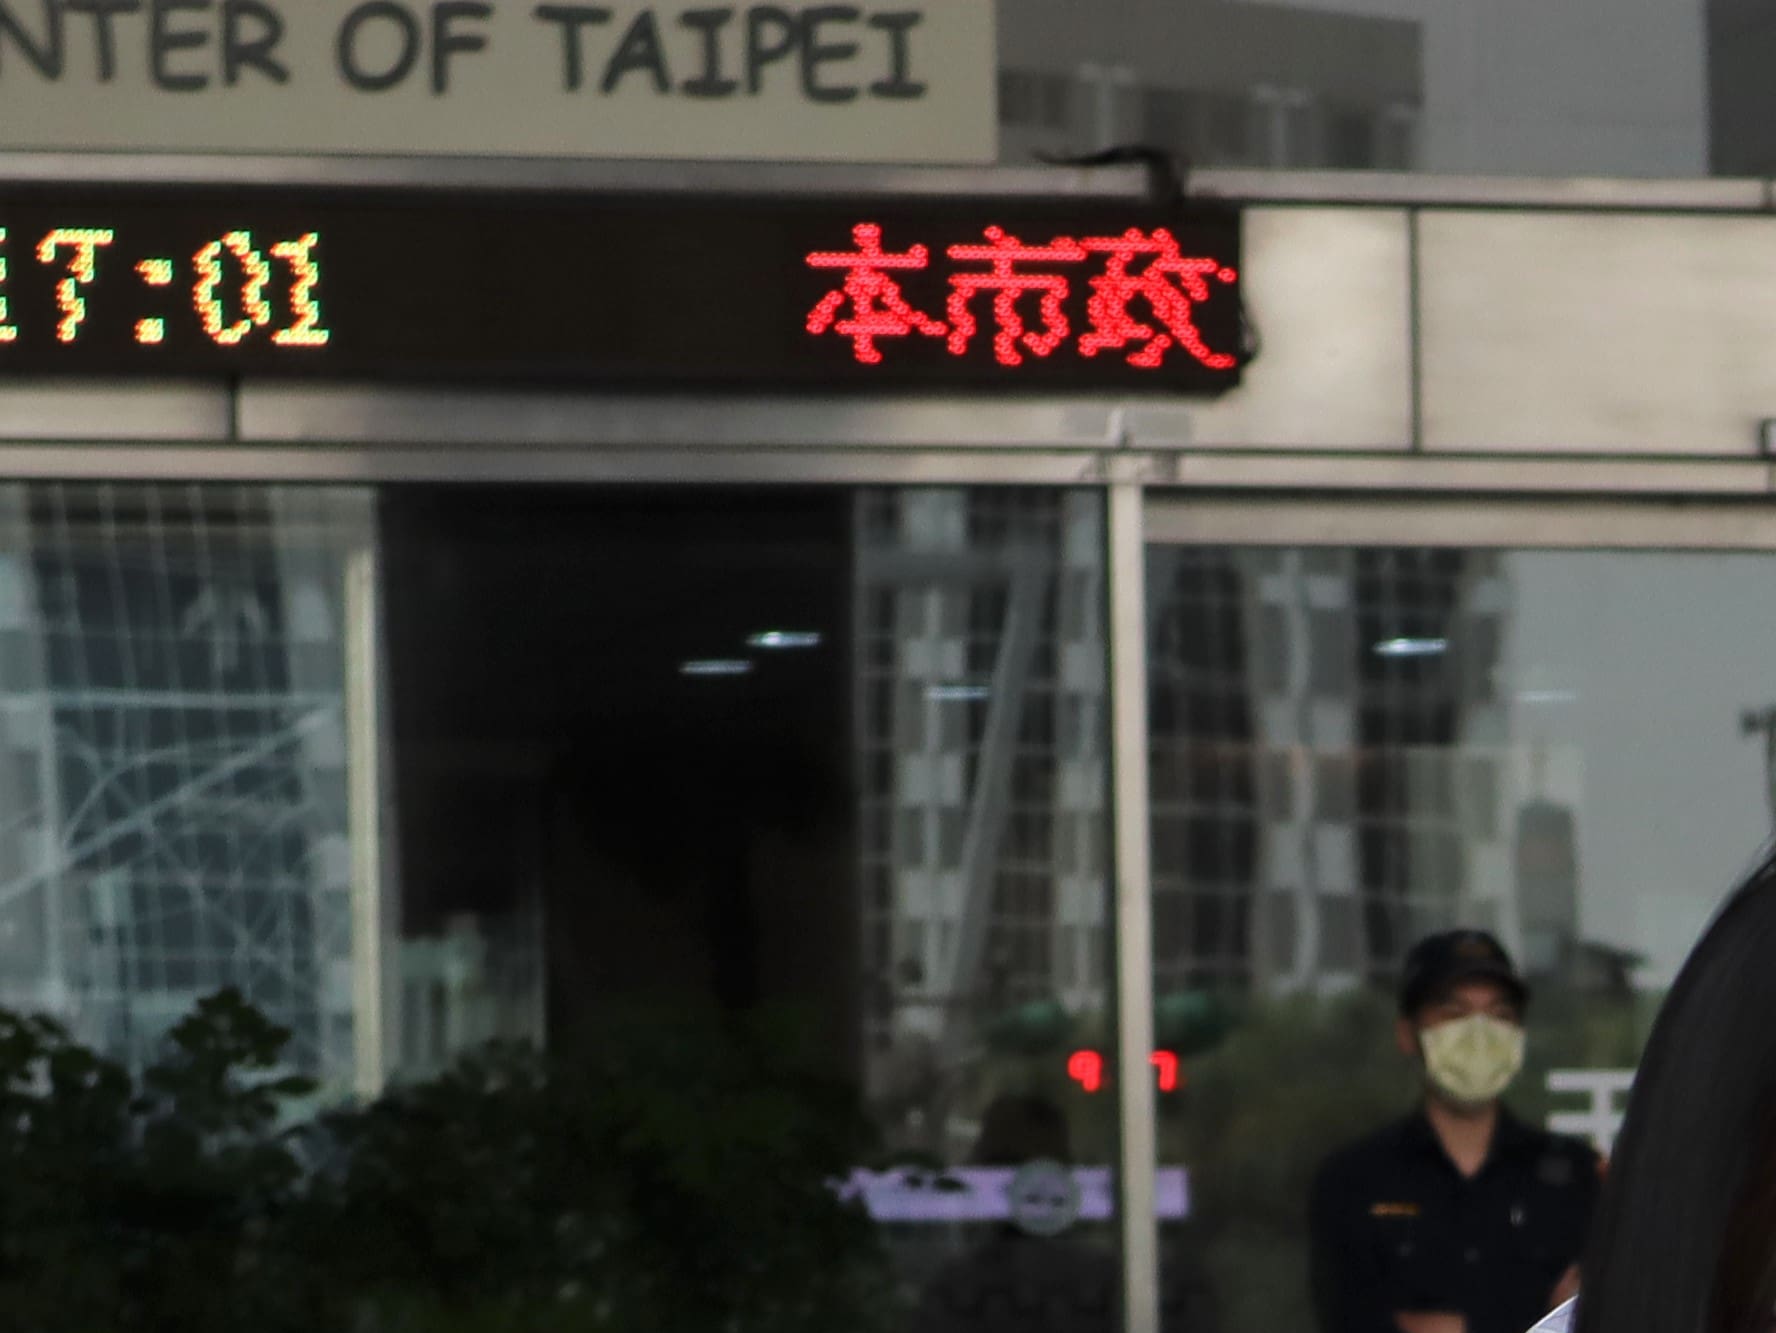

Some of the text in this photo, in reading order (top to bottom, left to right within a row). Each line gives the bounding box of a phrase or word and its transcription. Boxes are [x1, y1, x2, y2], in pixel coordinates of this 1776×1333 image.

[336, 0, 492, 95] OF
[532, 4, 926, 101] TAIPEI
[0, 227, 329, 344] 7:01
[805, 223, 1236, 367] 本市政
